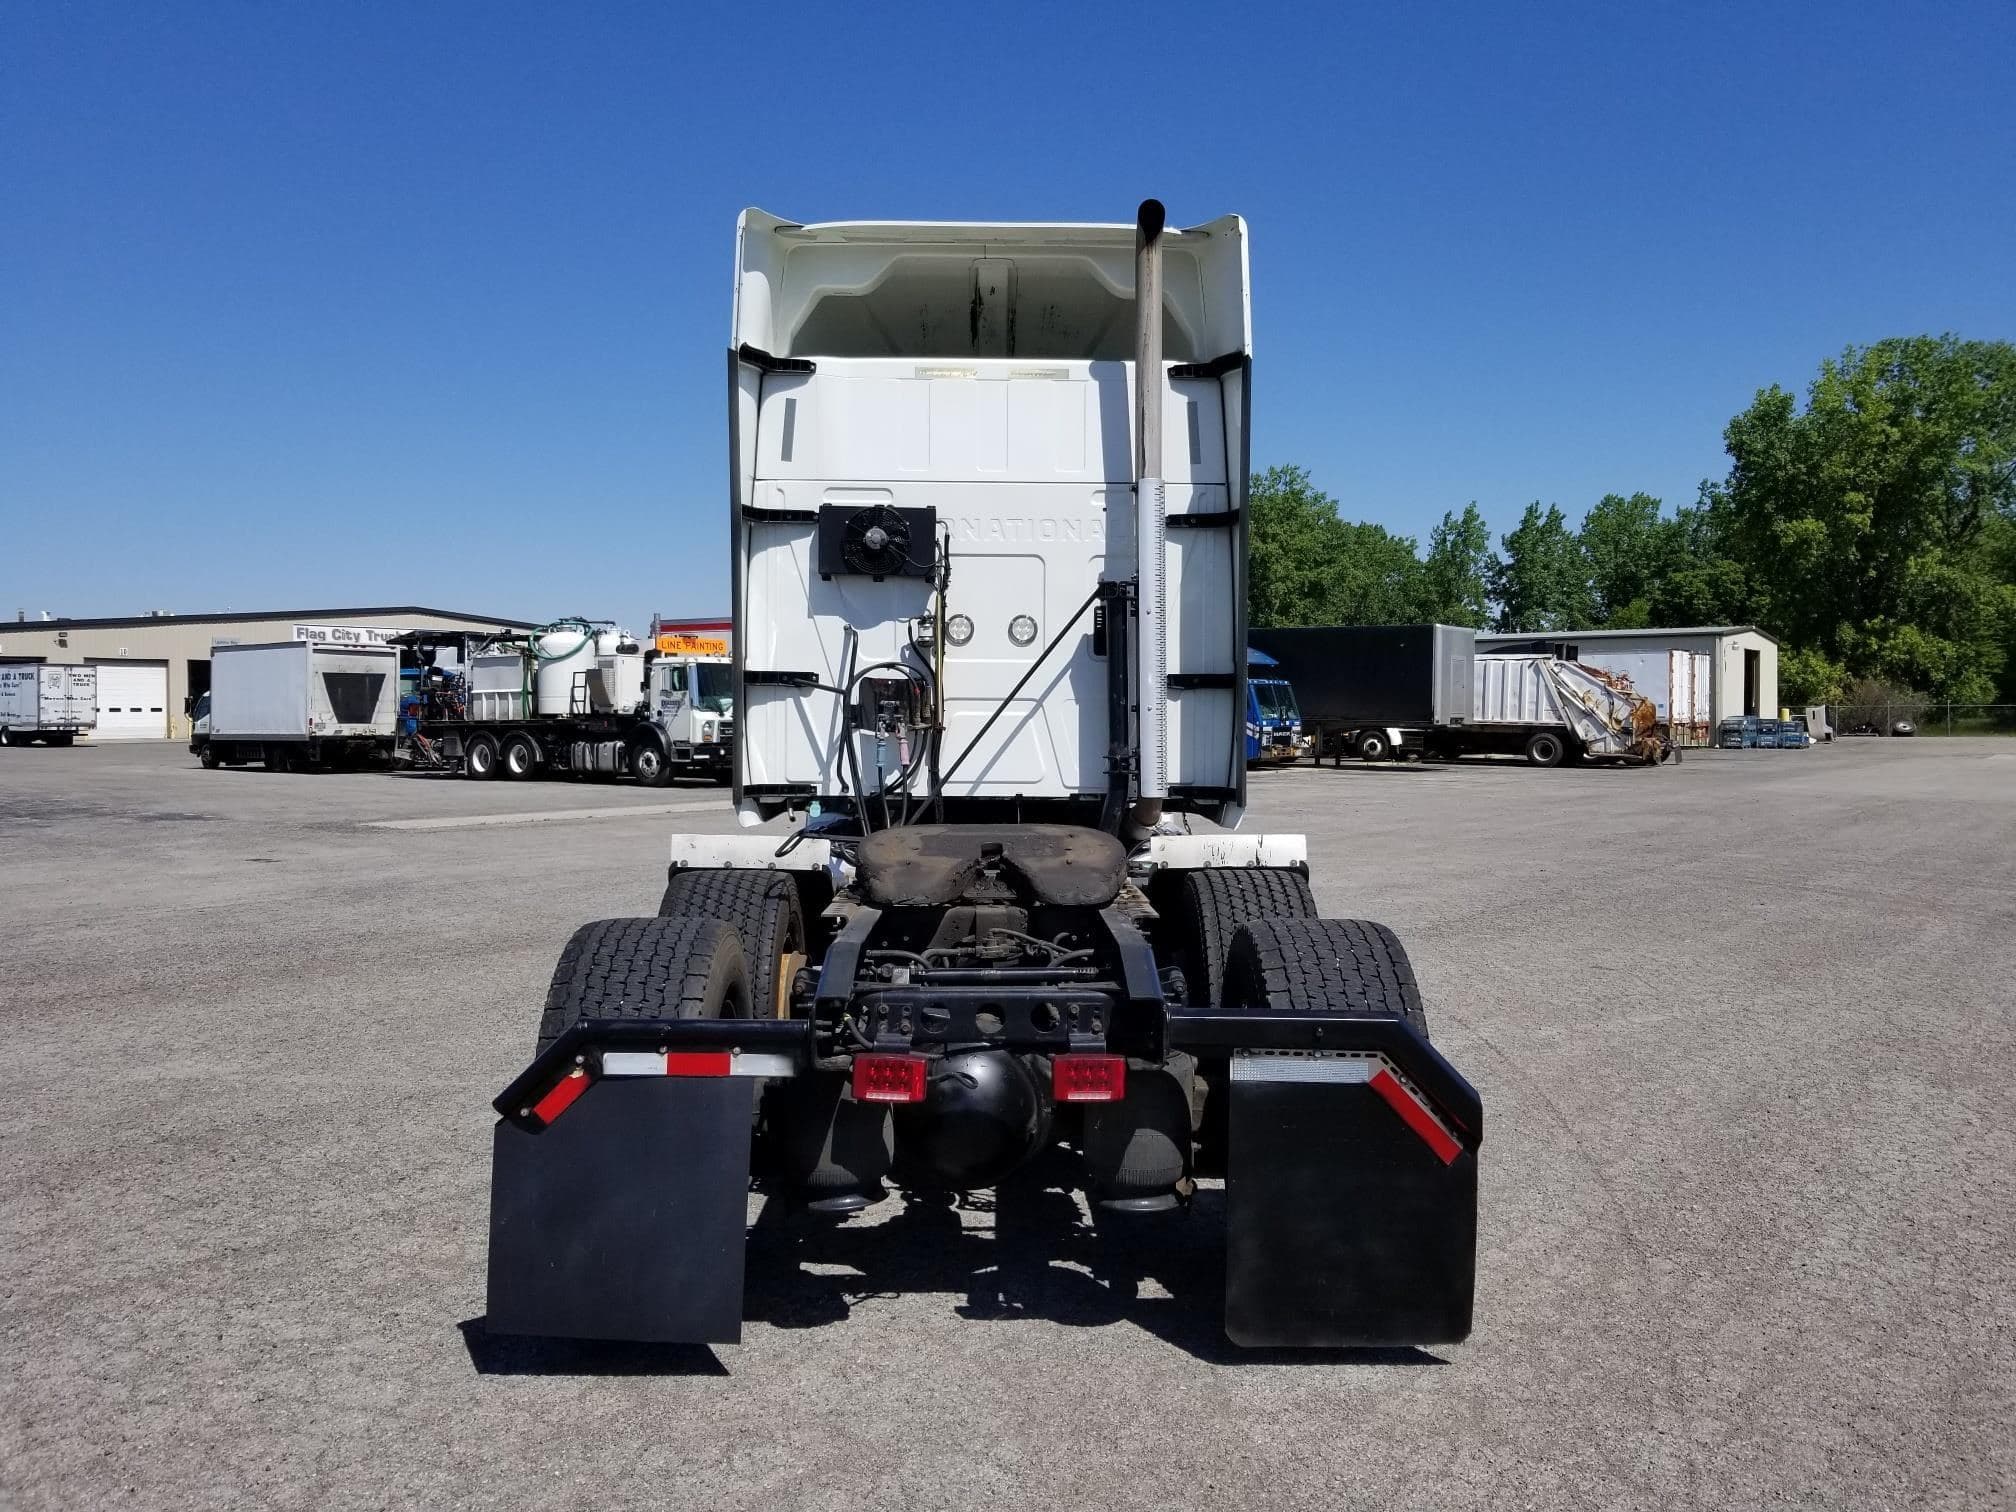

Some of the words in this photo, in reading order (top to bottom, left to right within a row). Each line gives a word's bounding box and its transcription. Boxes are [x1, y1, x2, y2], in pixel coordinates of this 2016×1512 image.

[296, 627, 326, 641] Flag
[332, 628, 360, 643] City
[661, 640, 682, 649] LINE
[685, 641, 724, 650] PAINTING
[18, 672, 35, 680] TRUCK
